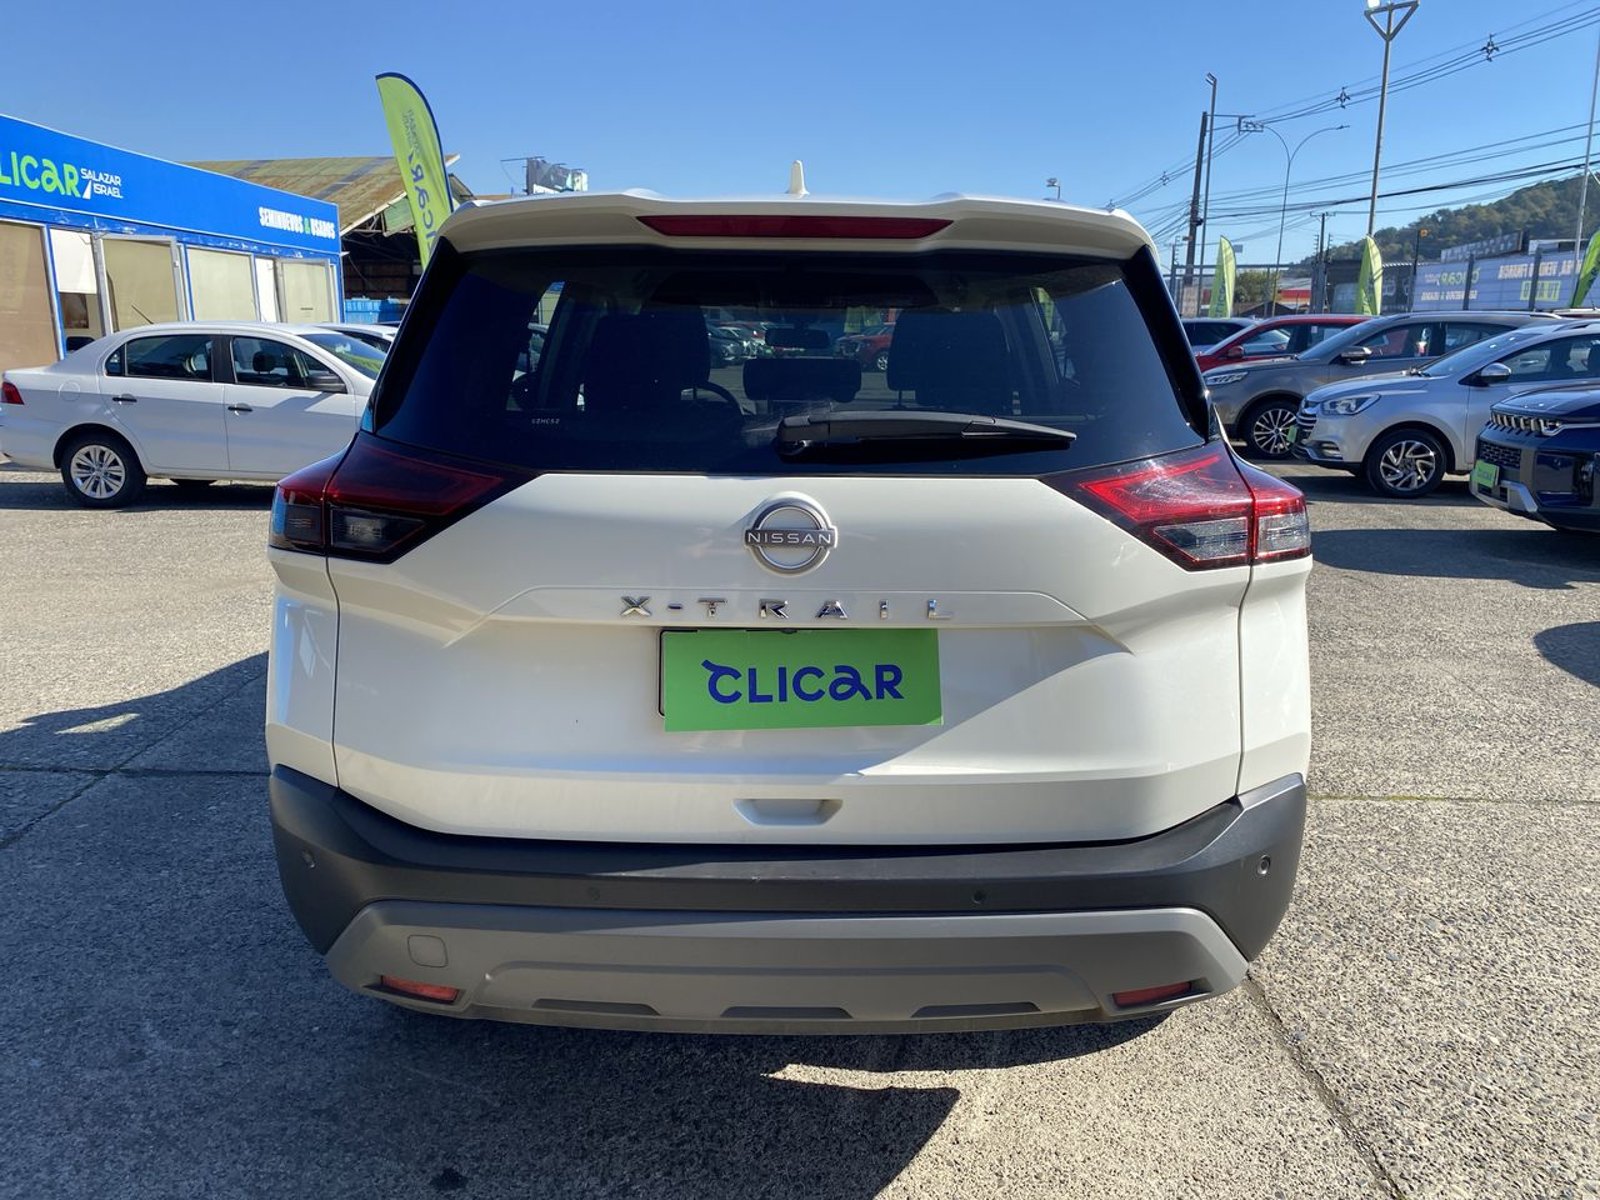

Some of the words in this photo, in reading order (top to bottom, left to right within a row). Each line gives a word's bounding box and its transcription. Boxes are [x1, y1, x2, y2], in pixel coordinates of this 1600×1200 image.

[80, 167, 122, 186] SALAZAR
[93, 183, 124, 199] ISRAEL
[258, 206, 304, 234] SEMINUEVOS
[304, 217, 311, 235] &
[310, 218, 336, 240] USADOS
[747, 531, 832, 545] NISSAN
[619, 595, 953, 620] X-TRAIL
